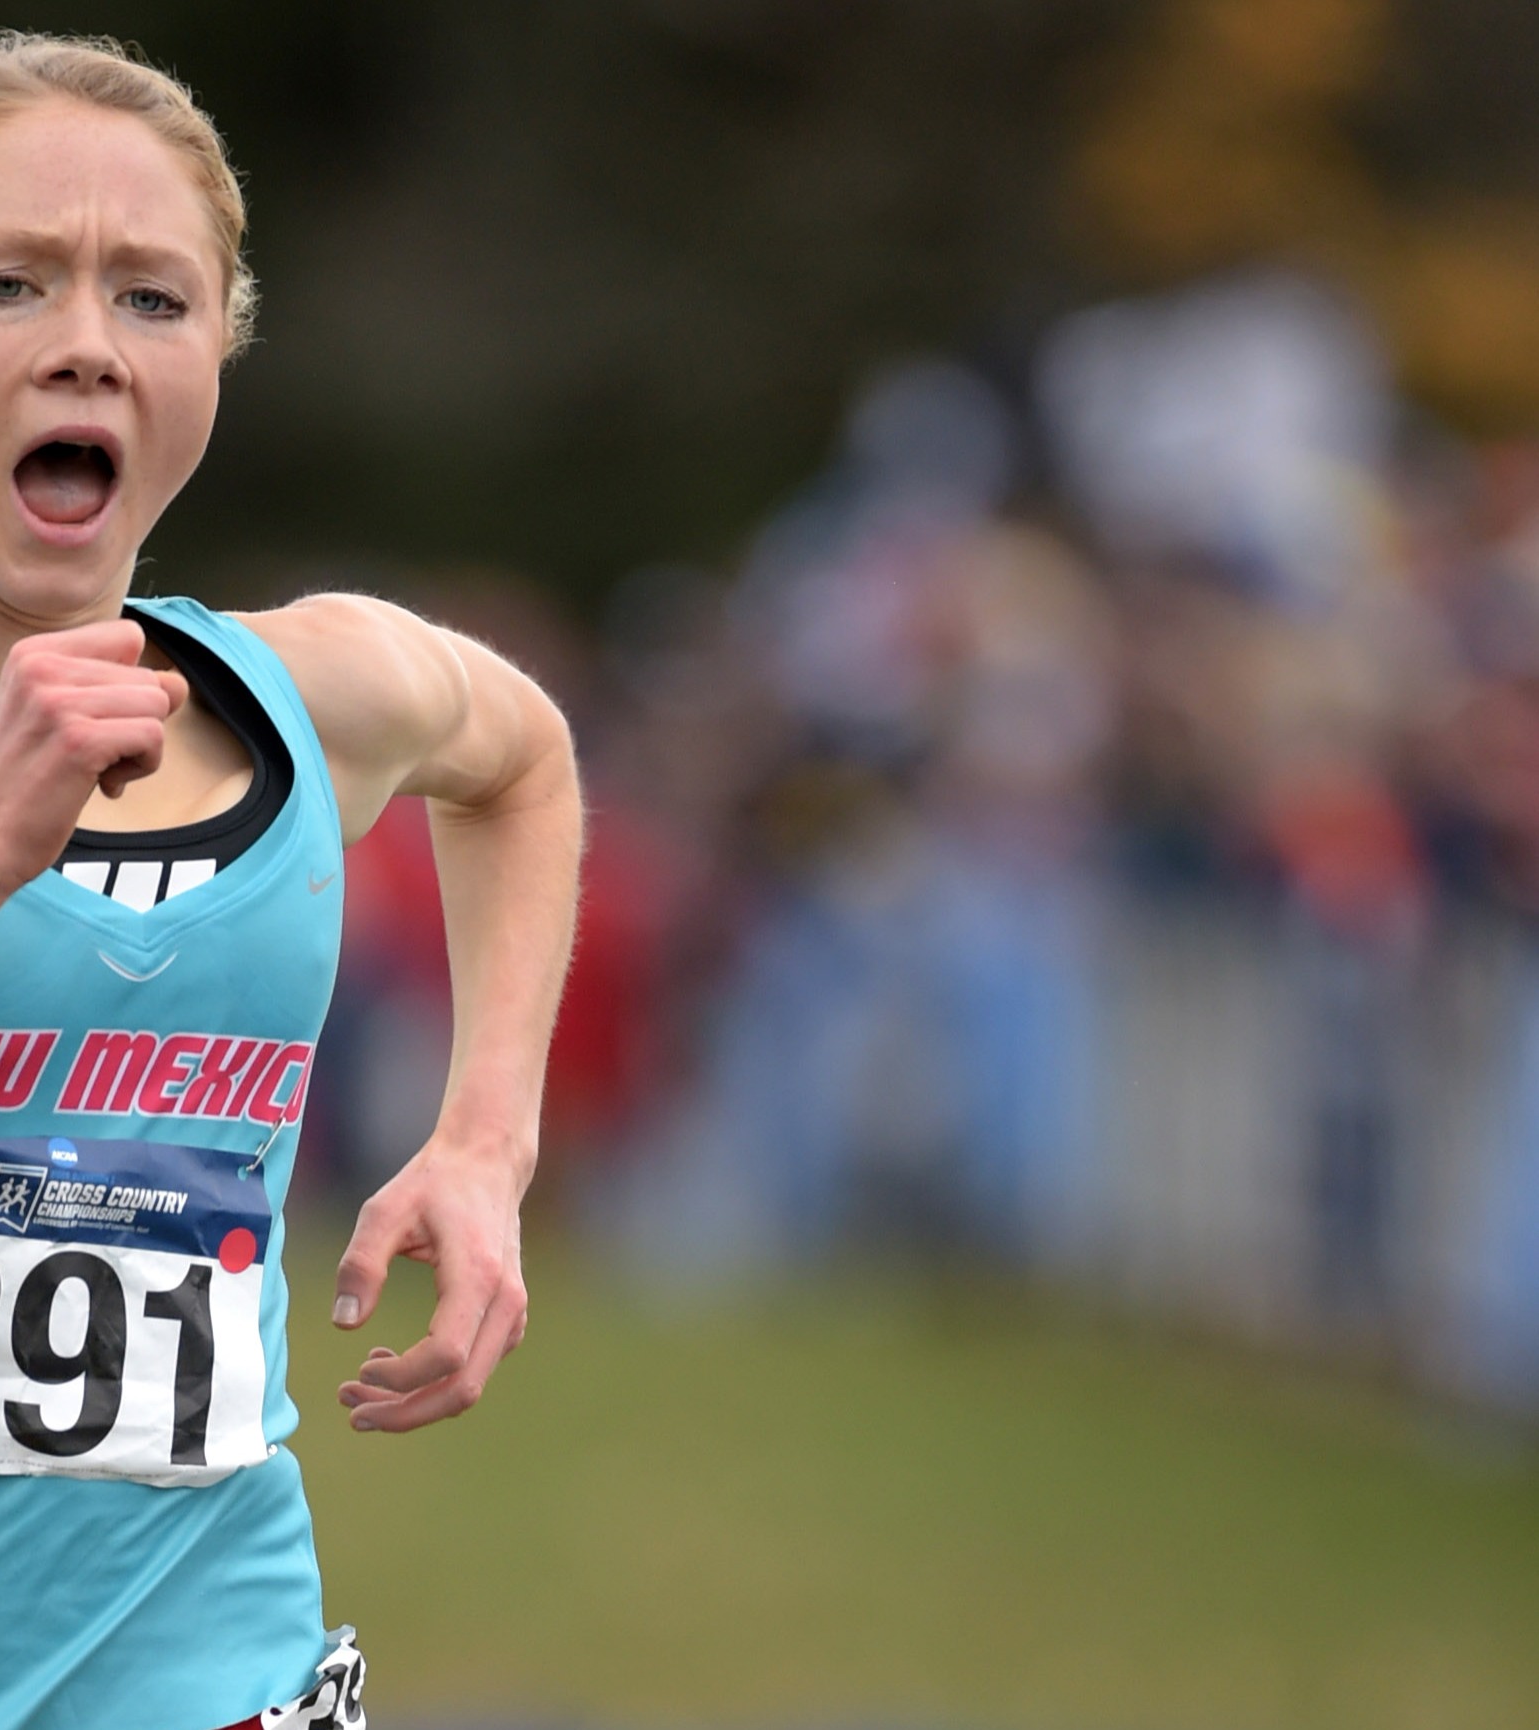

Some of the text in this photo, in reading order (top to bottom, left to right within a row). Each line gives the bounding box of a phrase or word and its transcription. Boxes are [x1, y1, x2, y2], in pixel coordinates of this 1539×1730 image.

[54, 1028, 314, 1127] MEXICO
[51, 1149, 79, 1164] NCAA
[43, 1180, 189, 1215] CROSS COUNTRY
[36, 1202, 137, 1224] CHAMPIONSHIPS
